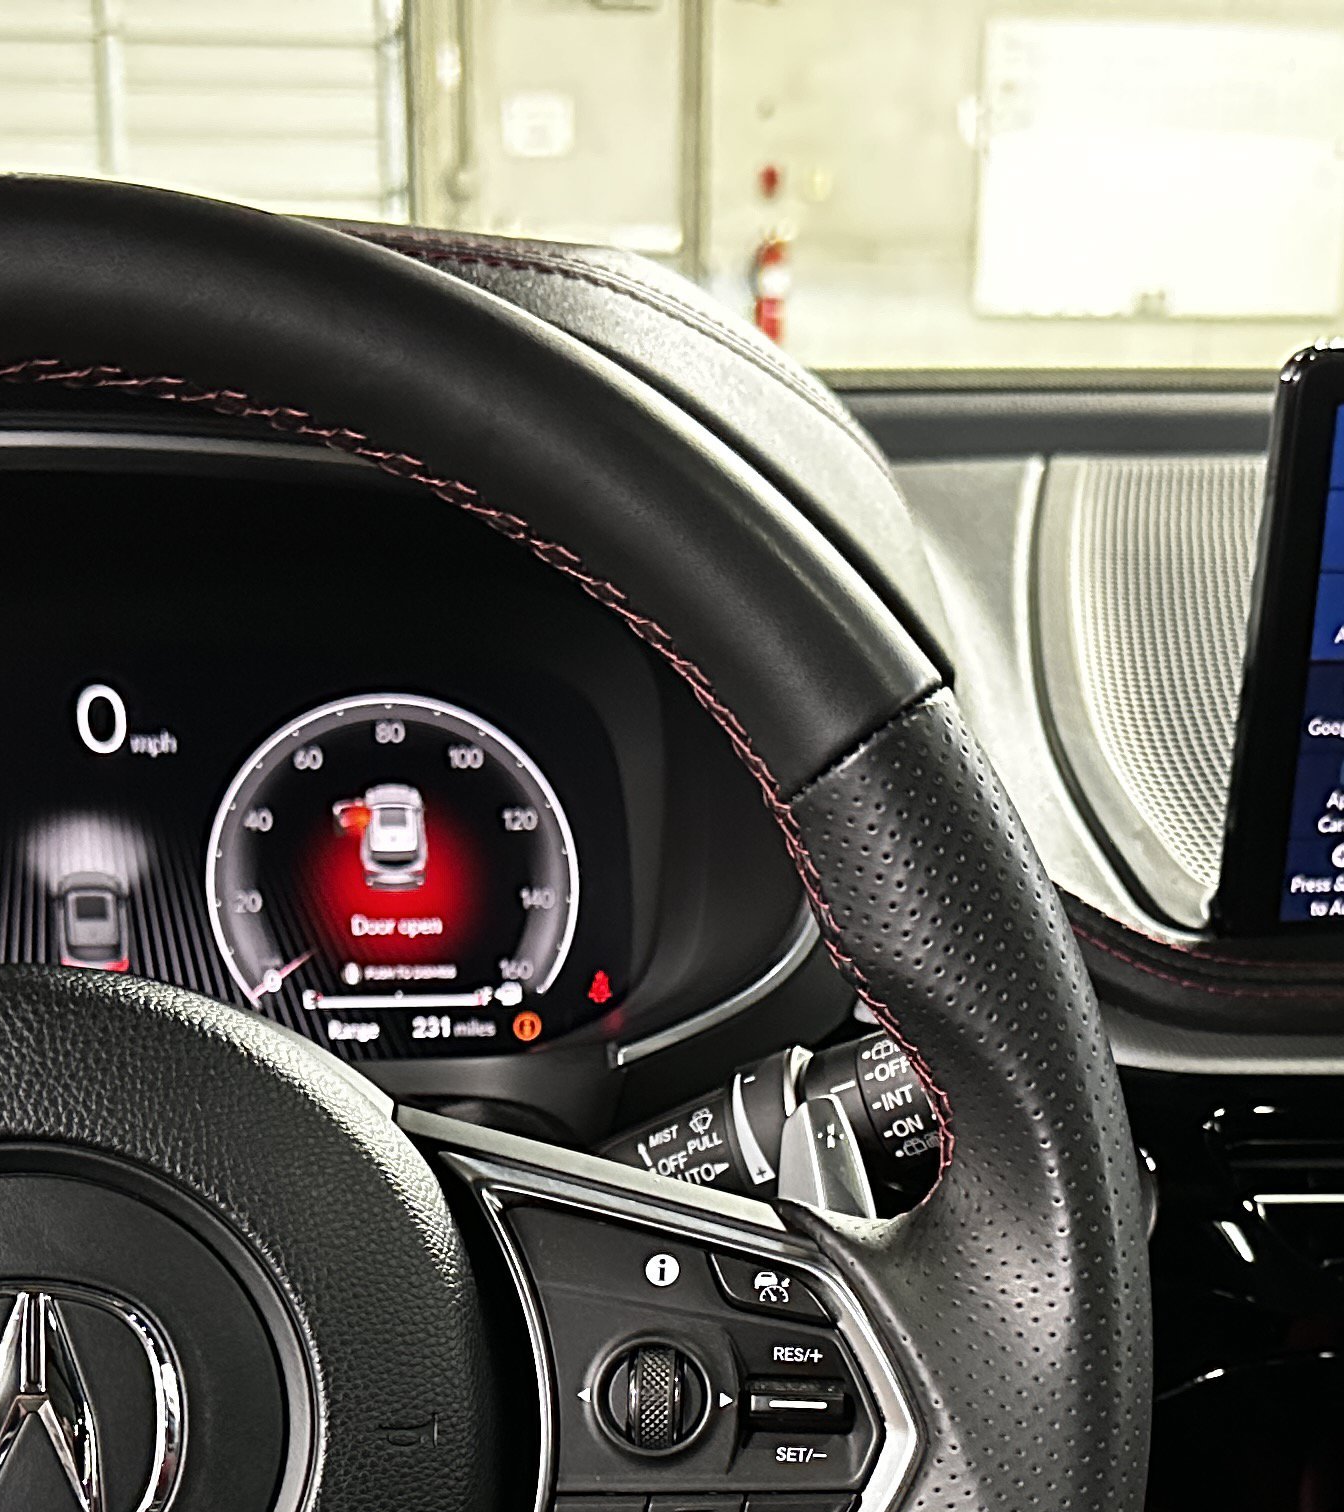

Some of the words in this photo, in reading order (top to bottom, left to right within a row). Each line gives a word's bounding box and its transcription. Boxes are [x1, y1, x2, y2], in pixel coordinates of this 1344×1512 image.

[76, 683, 127, 754] 0
[131, 728, 178, 758] mph
[374, 719, 406, 745] 80
[293, 745, 324, 771] 60
[448, 746, 485, 770] 100
[242, 807, 274, 833] 40
[502, 807, 539, 832] 120
[1290, 874, 1332, 893] Press
[234, 889, 263, 914] 20
[520, 887, 556, 911] 140
[1310, 899, 1327, 916] to
[351, 914, 396, 936] Door
[397, 916, 443, 938] open
[499, 959, 535, 981] 160
[328, 1019, 380, 1042] Range
[412, 1015, 451, 1038] 231
[453, 1017, 497, 1037] miles
[874, 1055, 911, 1082] OFF
[880, 1083, 913, 1112] INT
[648, 1124, 679, 1148] MIST
[892, 1113, 924, 1138] ON
[686, 1132, 724, 1155] PULL
[657, 1150, 688, 1177] OFF
[773, 1345, 824, 1364] RES/+
